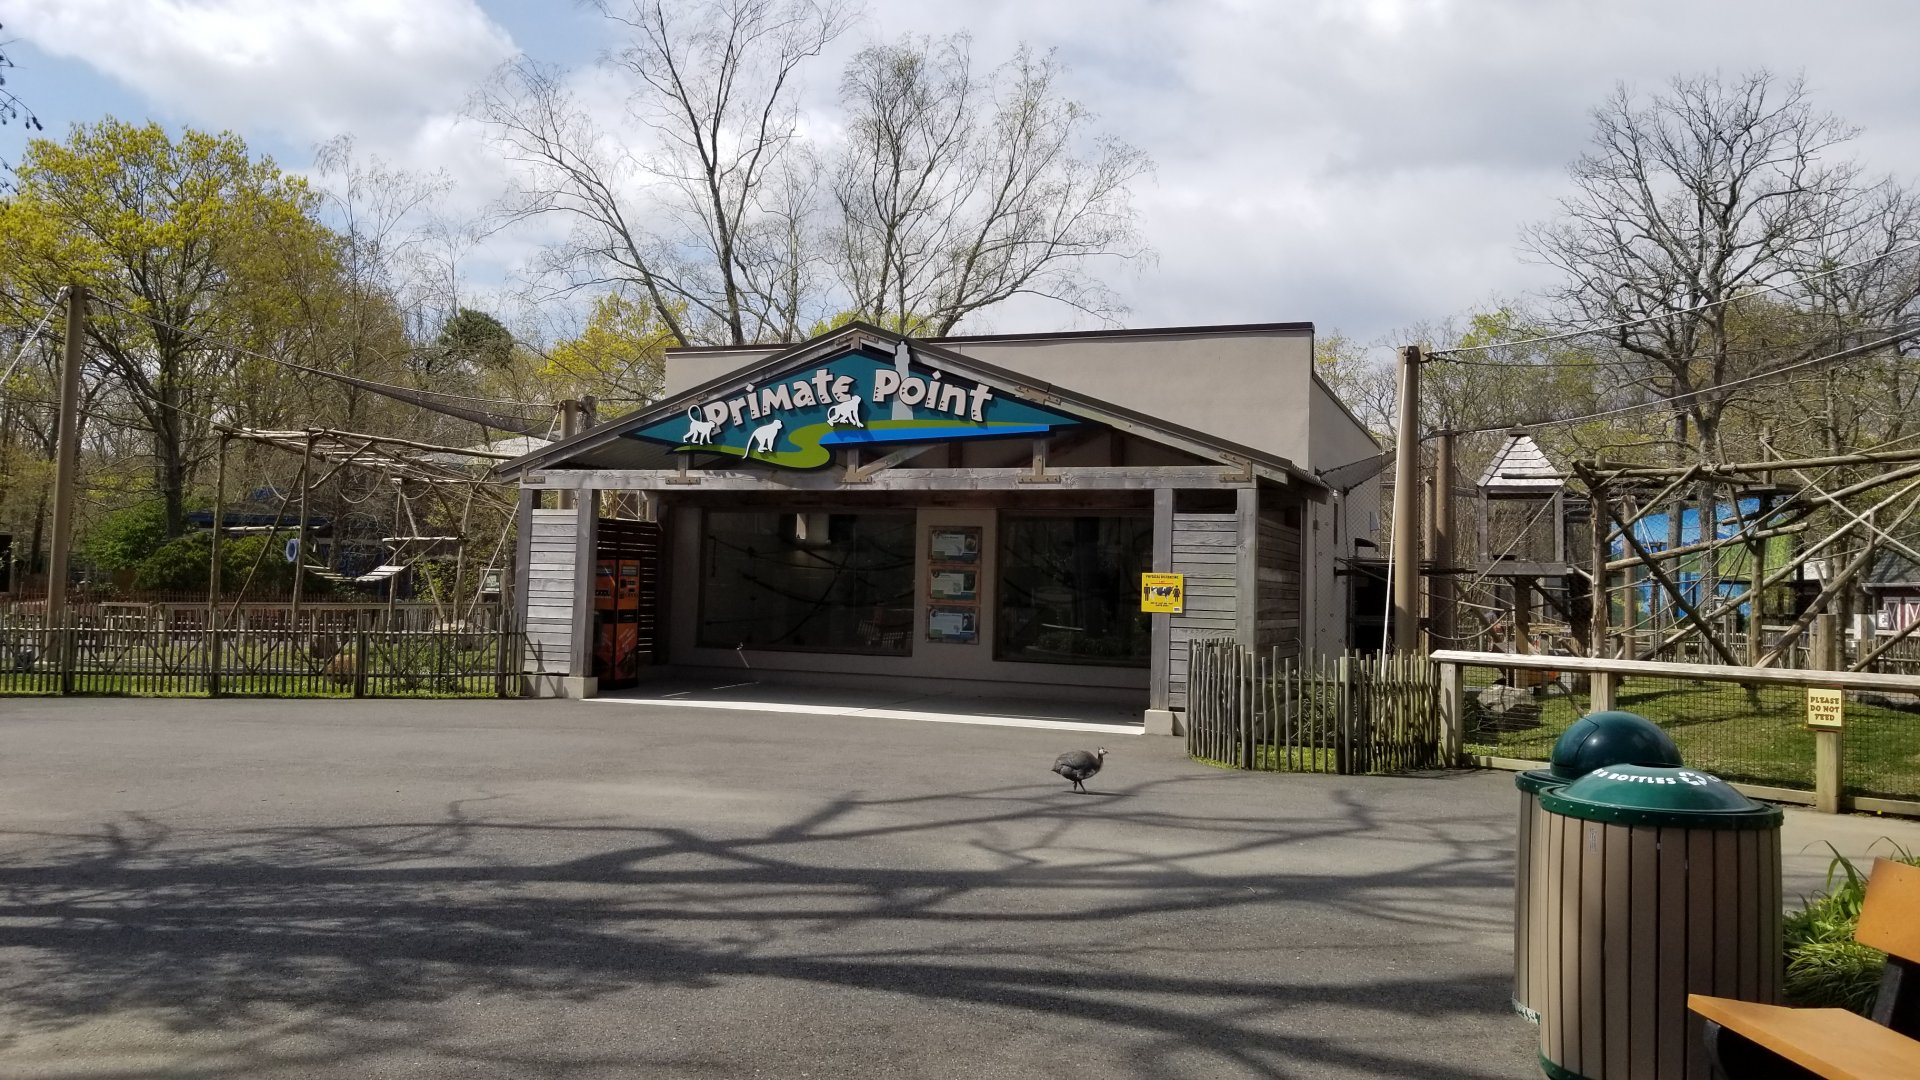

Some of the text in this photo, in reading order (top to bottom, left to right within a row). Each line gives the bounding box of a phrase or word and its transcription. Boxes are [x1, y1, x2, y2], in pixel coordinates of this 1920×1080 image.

[872, 369, 993, 422] Point
[1810, 696, 1840, 704] PLEASE
[1814, 713, 1835, 721] FEED
[1608, 773, 1677, 785] BOTTLES
